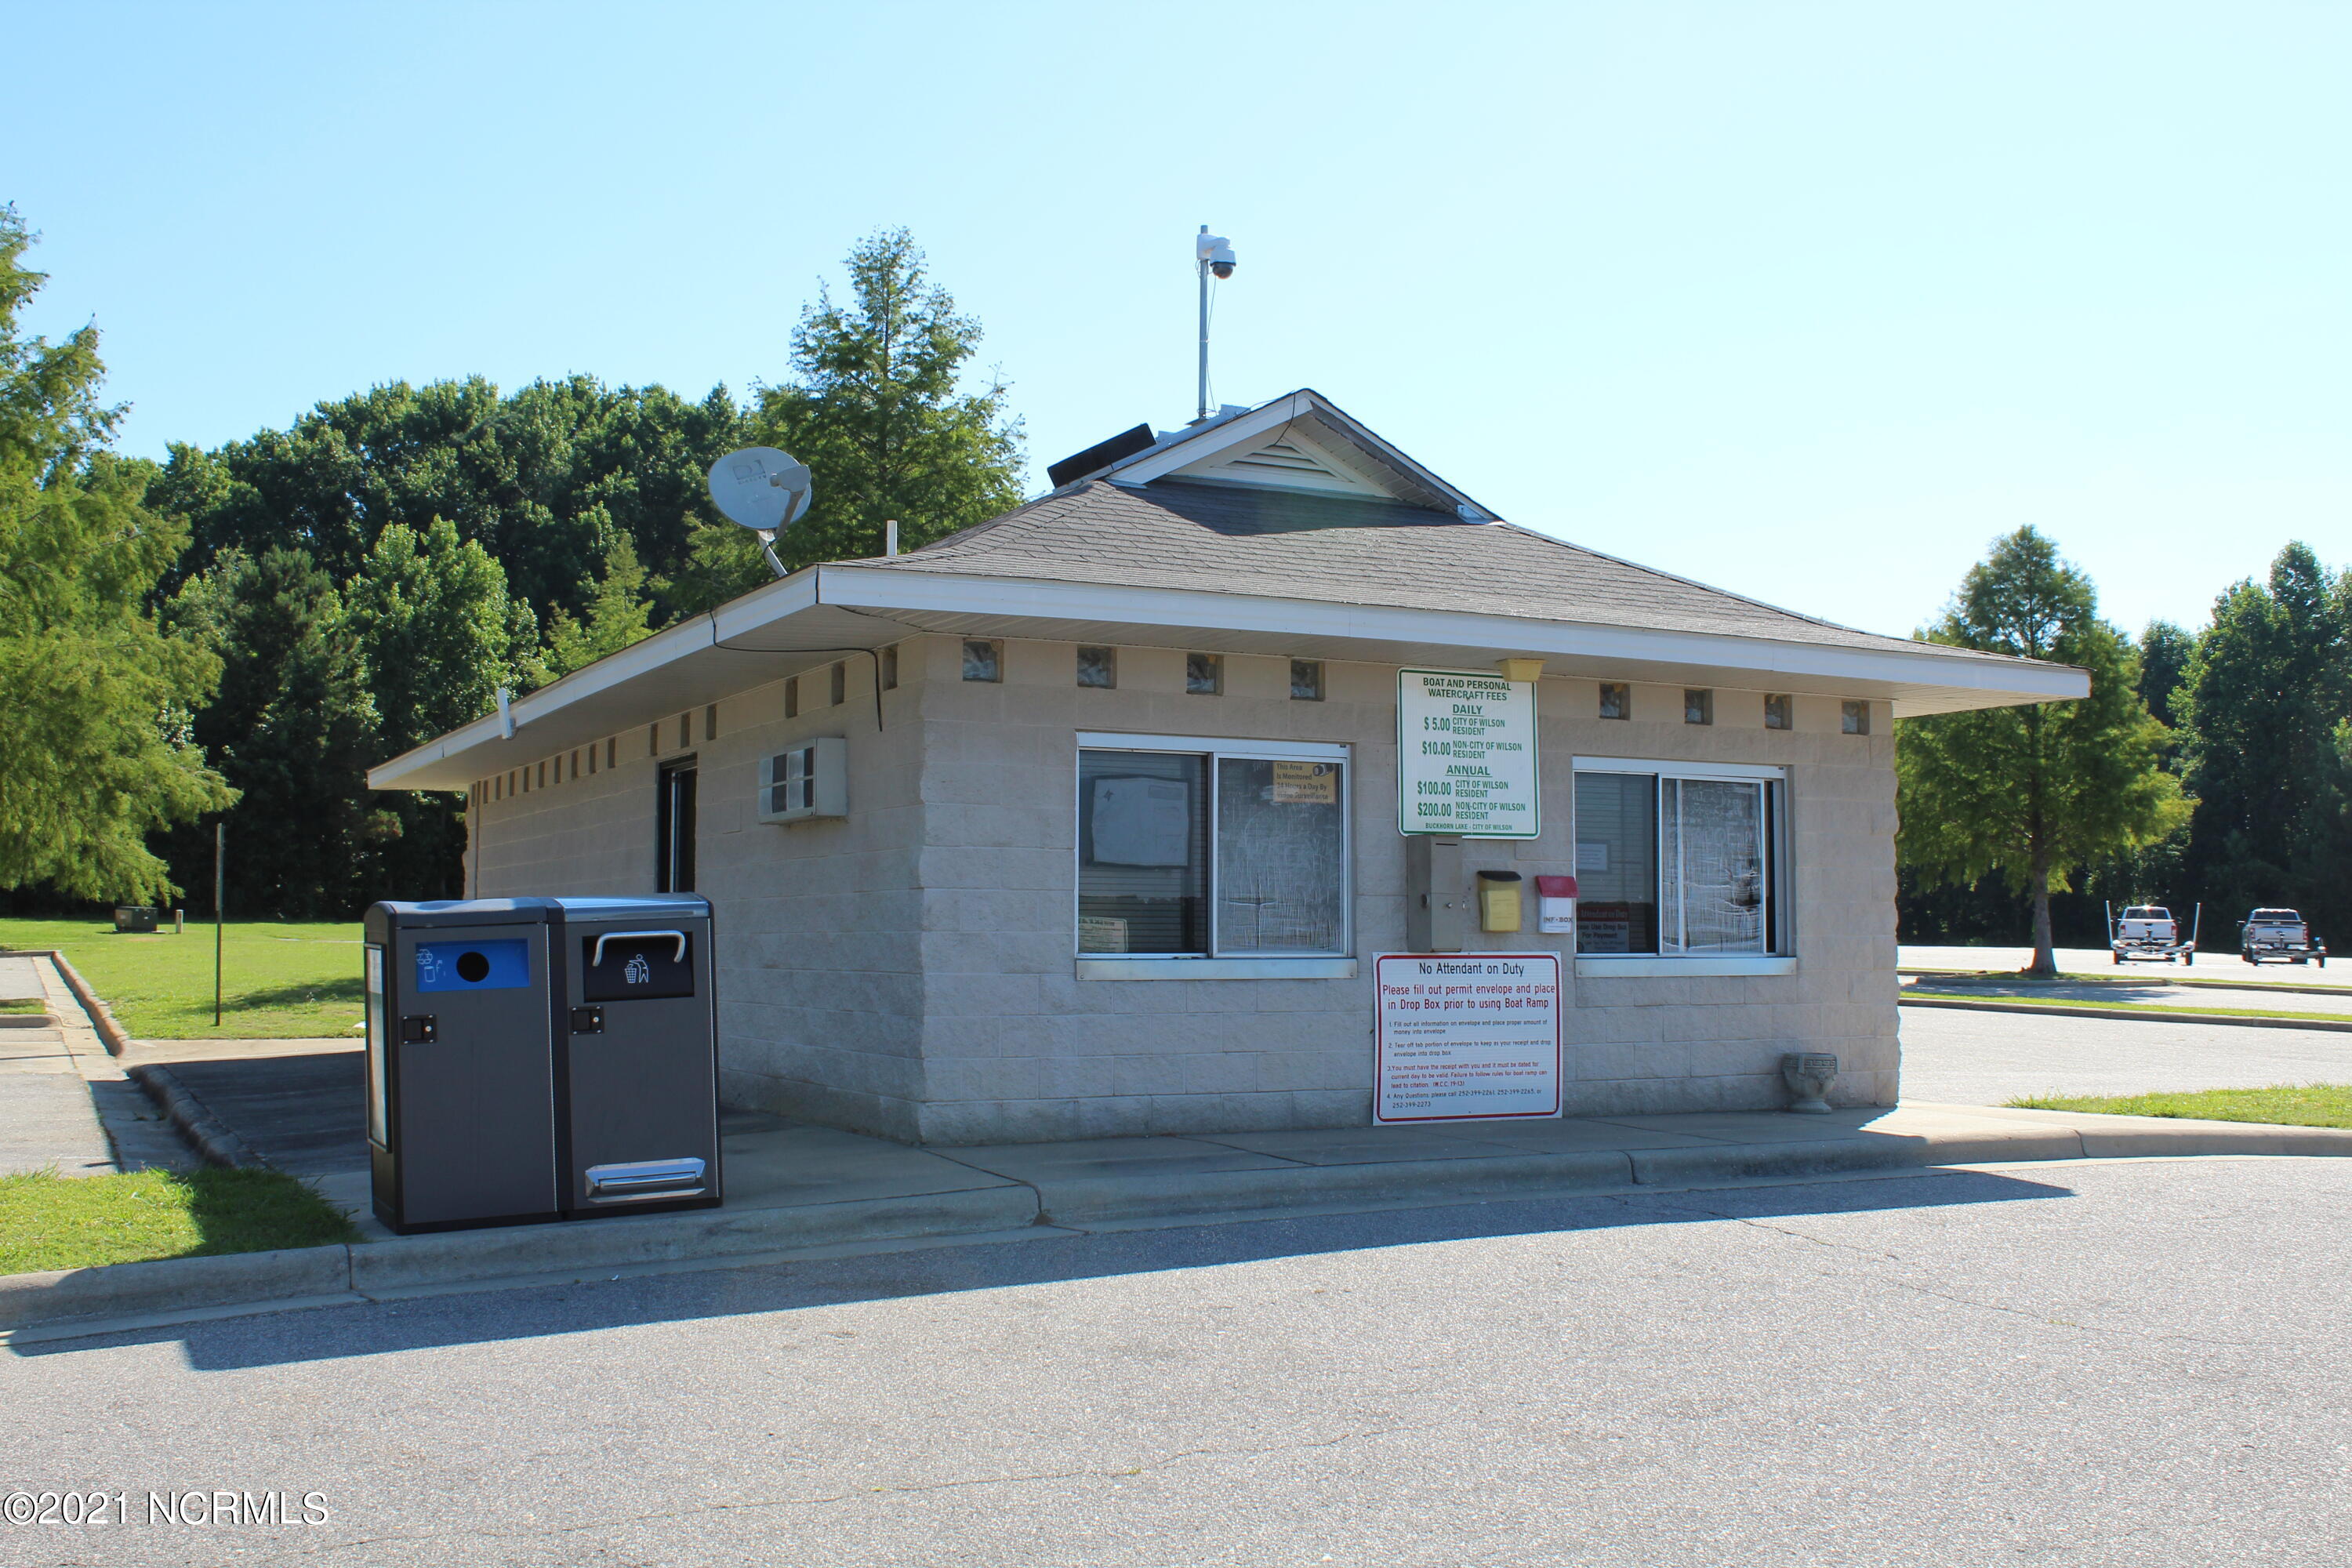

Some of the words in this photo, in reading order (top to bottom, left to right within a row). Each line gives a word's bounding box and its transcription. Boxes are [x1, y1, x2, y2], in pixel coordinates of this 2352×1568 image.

[1423, 677, 1445, 687] BOAT
[1446, 679, 1465, 688] AND
[1467, 681, 1512, 691] PERSONAL
[1428, 688, 1484, 699] WATERCRAFT
[1486, 691, 1507, 701] FEES
[1453, 704, 1483, 714] DAILY
[1453, 717, 1468, 726] CITY
[1469, 717, 1478, 726] OF
[1479, 718, 1505, 728] WILSON
[1453, 727, 1485, 735] RESIDENT
[1422, 741, 1450, 755] $10.00
[1453, 740, 1484, 750] NON-CITY
[1496, 742, 1522, 751] WILSON
[1453, 750, 1485, 759] RESIDENT
[1446, 765, 1490, 775] ANNUAL
[1417, 781, 1451, 796] $100.00
[1456, 780, 1470, 789] CITY
[1472, 780, 1481, 789] OF
[1483, 781, 1508, 789] WILSON
[1456, 789, 1488, 797] RESIDENT
[1417, 802, 1451, 816] $200.00
[1456, 801, 1487, 811] NON-CITY
[1456, 811, 1489, 819] RESIDENT
[1419, 963, 1432, 975] No
[1436, 962, 1482, 975] Attendant
[1486, 965, 1498, 975] on
[1503, 963, 1524, 977] Duty
[1383, 984, 1410, 995] Please
[1414, 984, 1425, 995] fill
[1428, 985, 1442, 994] out
[1446, 983, 1472, 996] permit
[1476, 983, 1512, 995] envelope
[1516, 983, 1530, 993] and
[1534, 982, 1555, 995] place
[1388, 999, 1396, 1010] in
[1400, 999, 1420, 1011] Drop
[1425, 999, 1440, 1009] Box
[1444, 998, 1464, 1011] prior
[1468, 998, 1475, 1008] to
[1479, 998, 1501, 1011] using
[1505, 998, 1523, 1008] Boat
[1526, 997, 1548, 1010] Ramp
